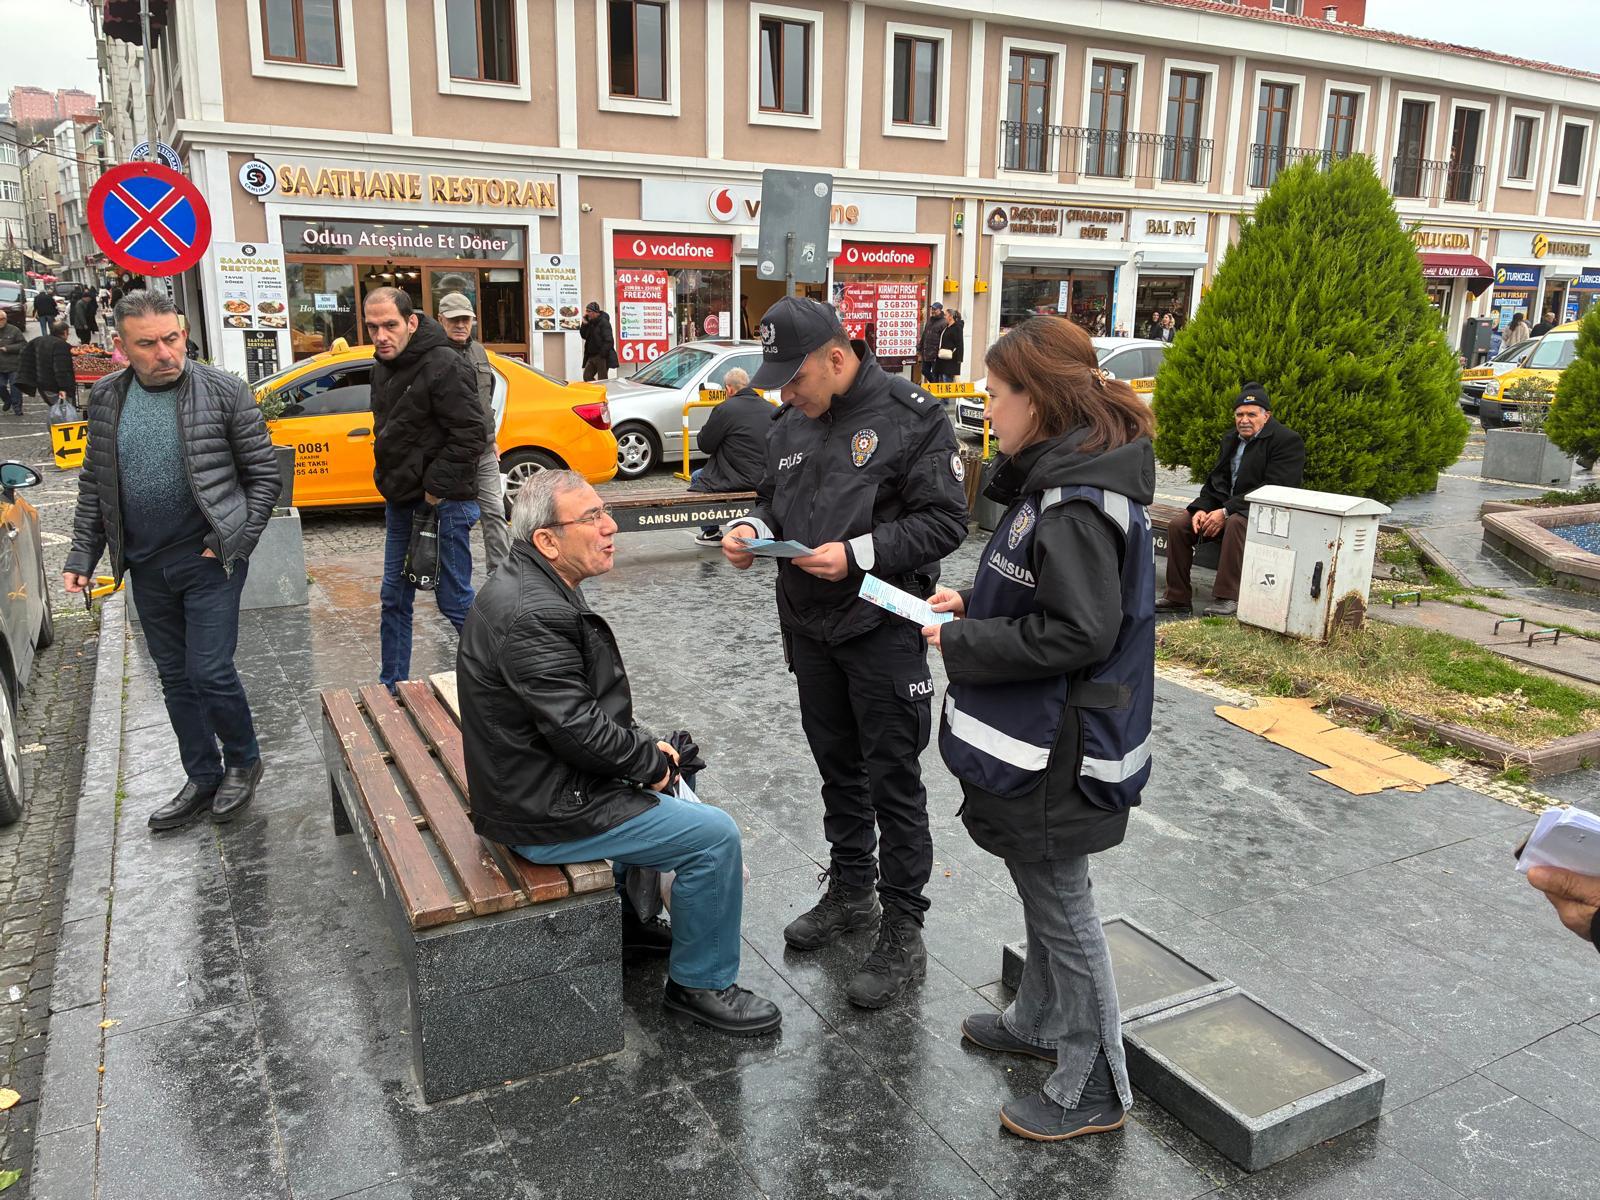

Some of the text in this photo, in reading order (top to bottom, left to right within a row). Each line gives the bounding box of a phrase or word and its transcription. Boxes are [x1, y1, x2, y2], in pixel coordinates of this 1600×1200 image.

[279, 164, 557, 209] SAATHANE RESTORAN
[1146, 216, 1197, 236] BAL EVİ
[303, 228, 509, 251] Odun Ateşinde Et Döner
[1441, 233, 1470, 249] GIDA
[650, 242, 714, 257] vodafone
[861, 249, 915, 264] vodafone
[619, 273, 632, 284] 40
[641, 274, 655, 284] 40
[656, 277, 666, 285] GB
[1438, 267, 1460, 276] UNLU
[1460, 268, 1480, 277] GIDA
[1506, 271, 1535, 282] TURKCELL
[623, 291, 662, 299] FREEZONE
[878, 285, 899, 295] KIRMIZI
[900, 285, 918, 295] FIRSAT
[622, 342, 658, 361] 616
[58, 425, 88, 442] TA
[298, 442, 329, 454] 0081
[308, 460, 328, 468] TAKSİ
[639, 512, 689, 525] SAMSUN
